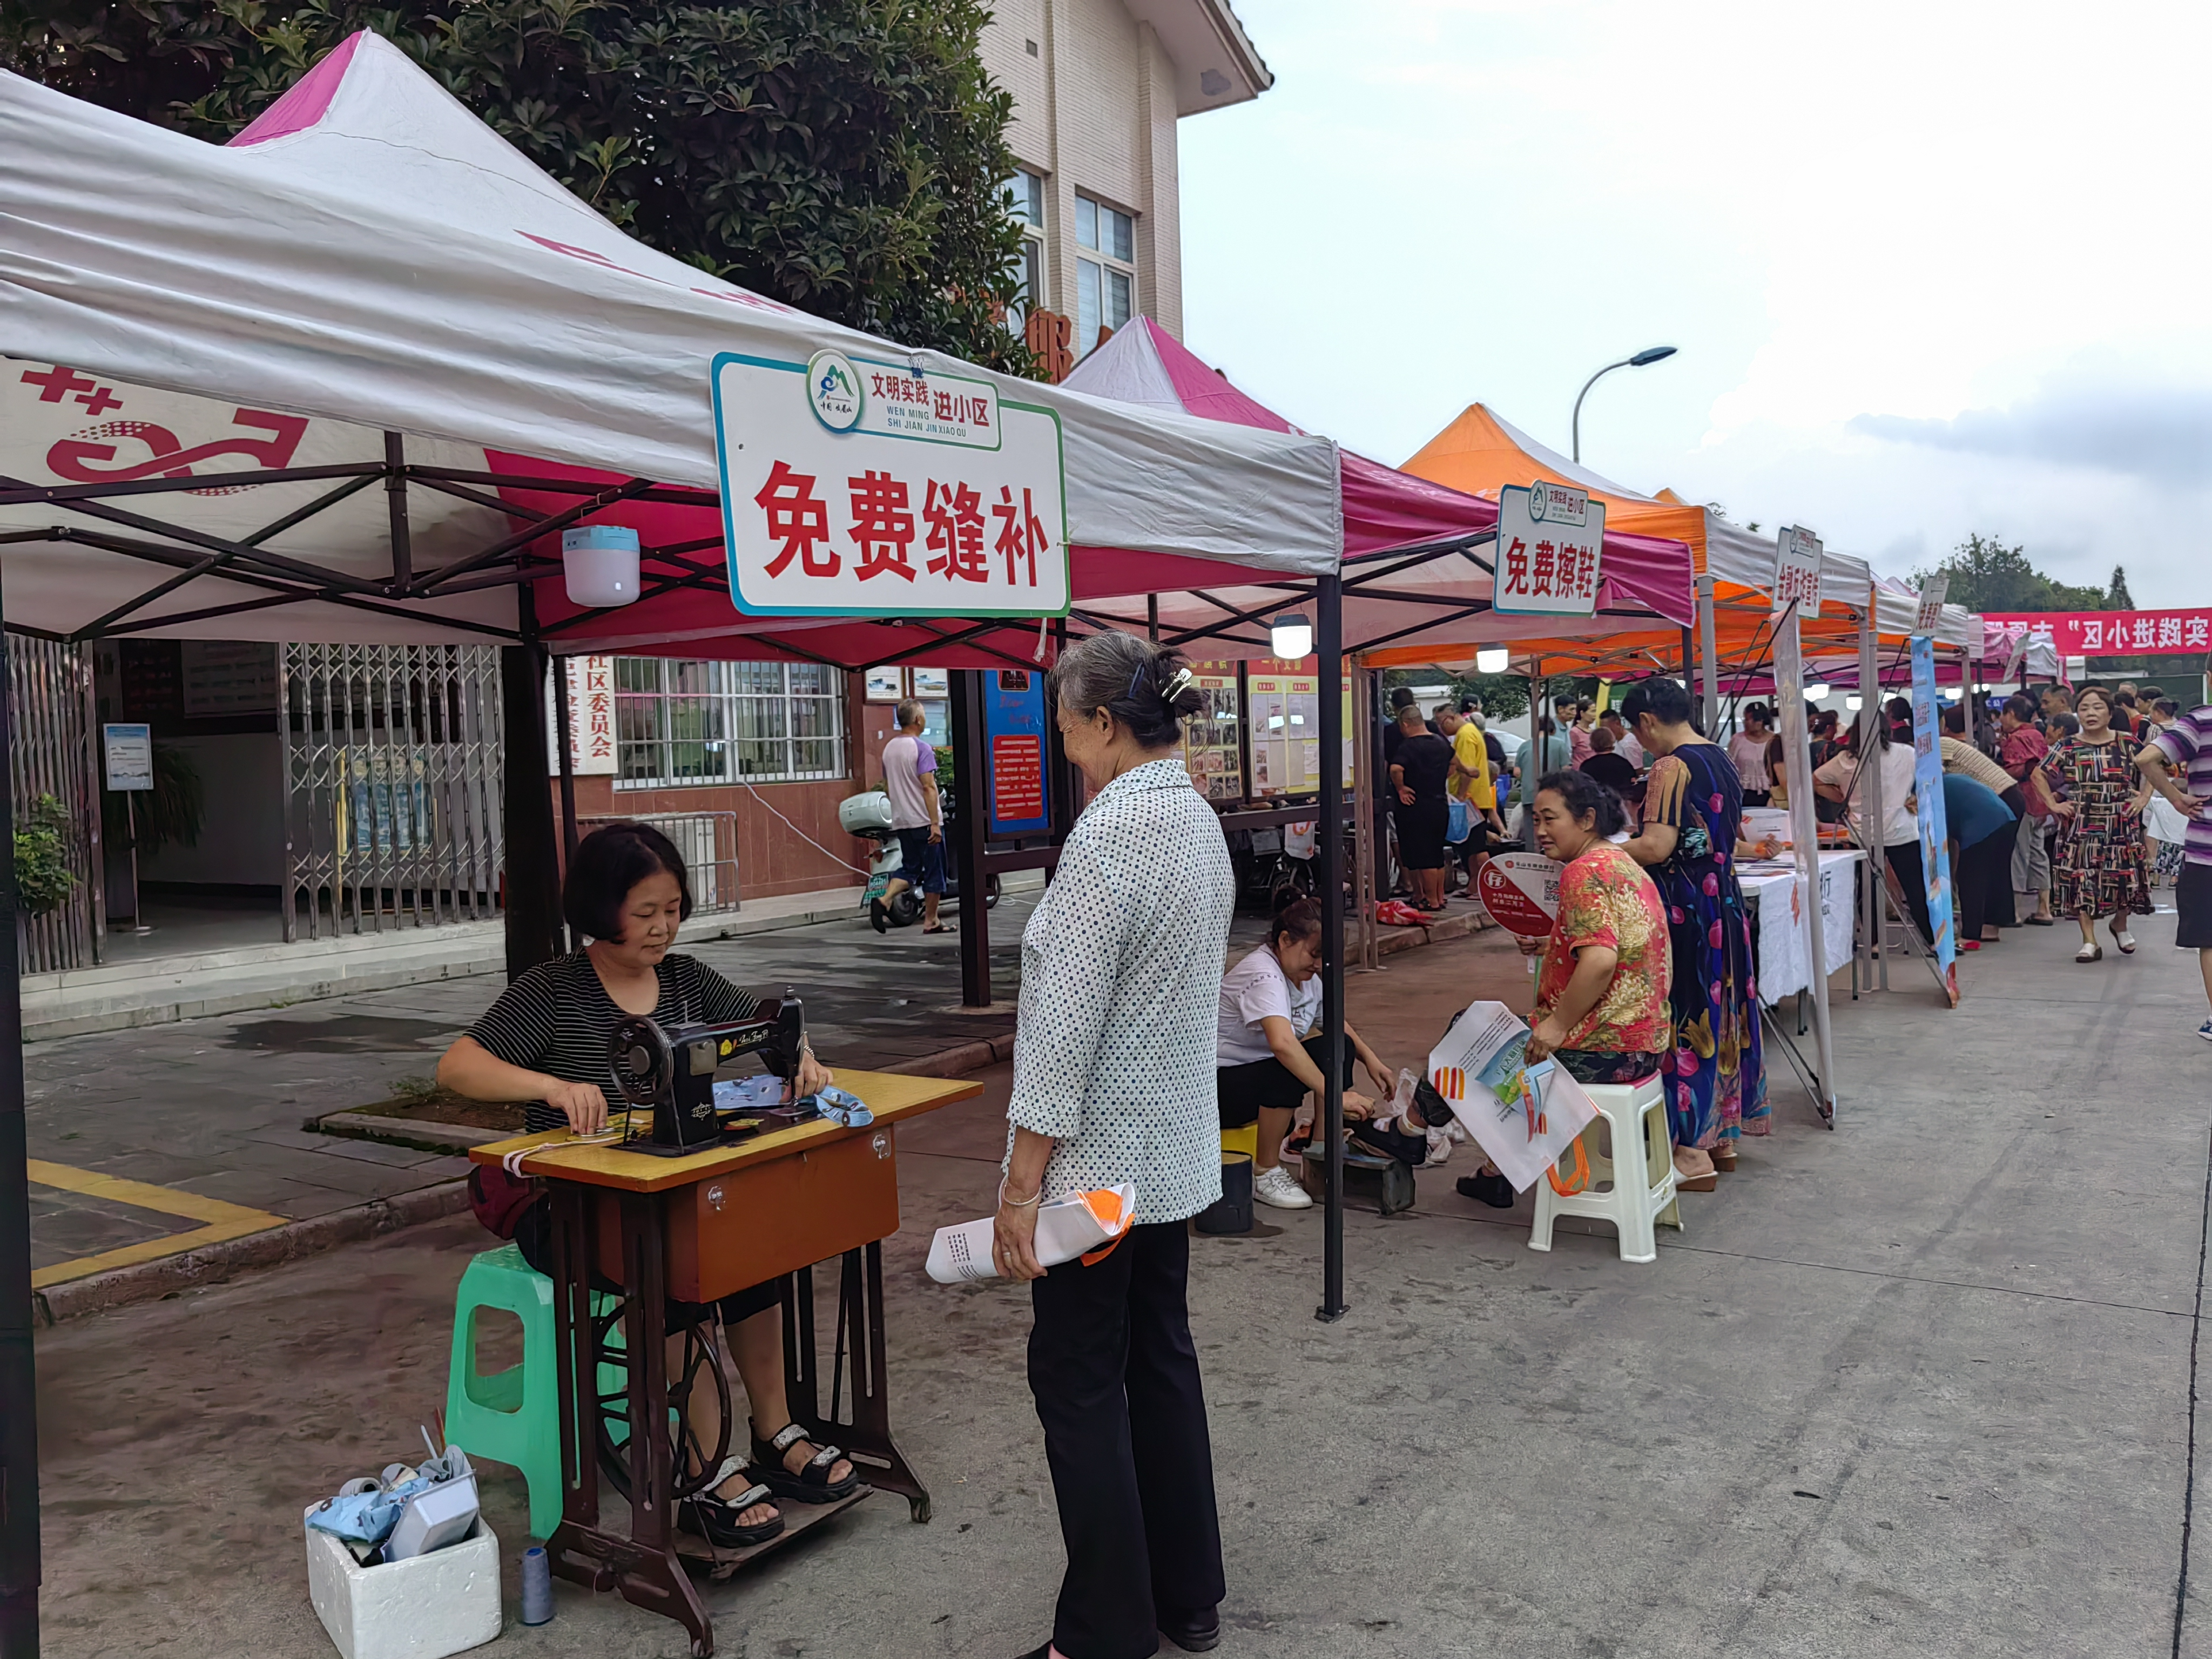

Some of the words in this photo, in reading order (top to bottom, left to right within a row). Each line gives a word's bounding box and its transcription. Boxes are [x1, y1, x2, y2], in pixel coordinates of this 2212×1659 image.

[871, 372, 929, 407] 文明实践
[933, 389, 990, 427] 进小区
[887, 406, 905, 417] WEN
[908, 409, 929, 420] MING
[887, 417, 901, 428] SHI
[905, 421, 923, 431] JIAN
[926, 423, 938, 433] JIN
[938, 425, 955, 436] XIAO
[956, 428, 967, 437] QU
[754, 459, 1049, 588] 免费缝补
[1504, 536, 1595, 599] 免费擦鞋
